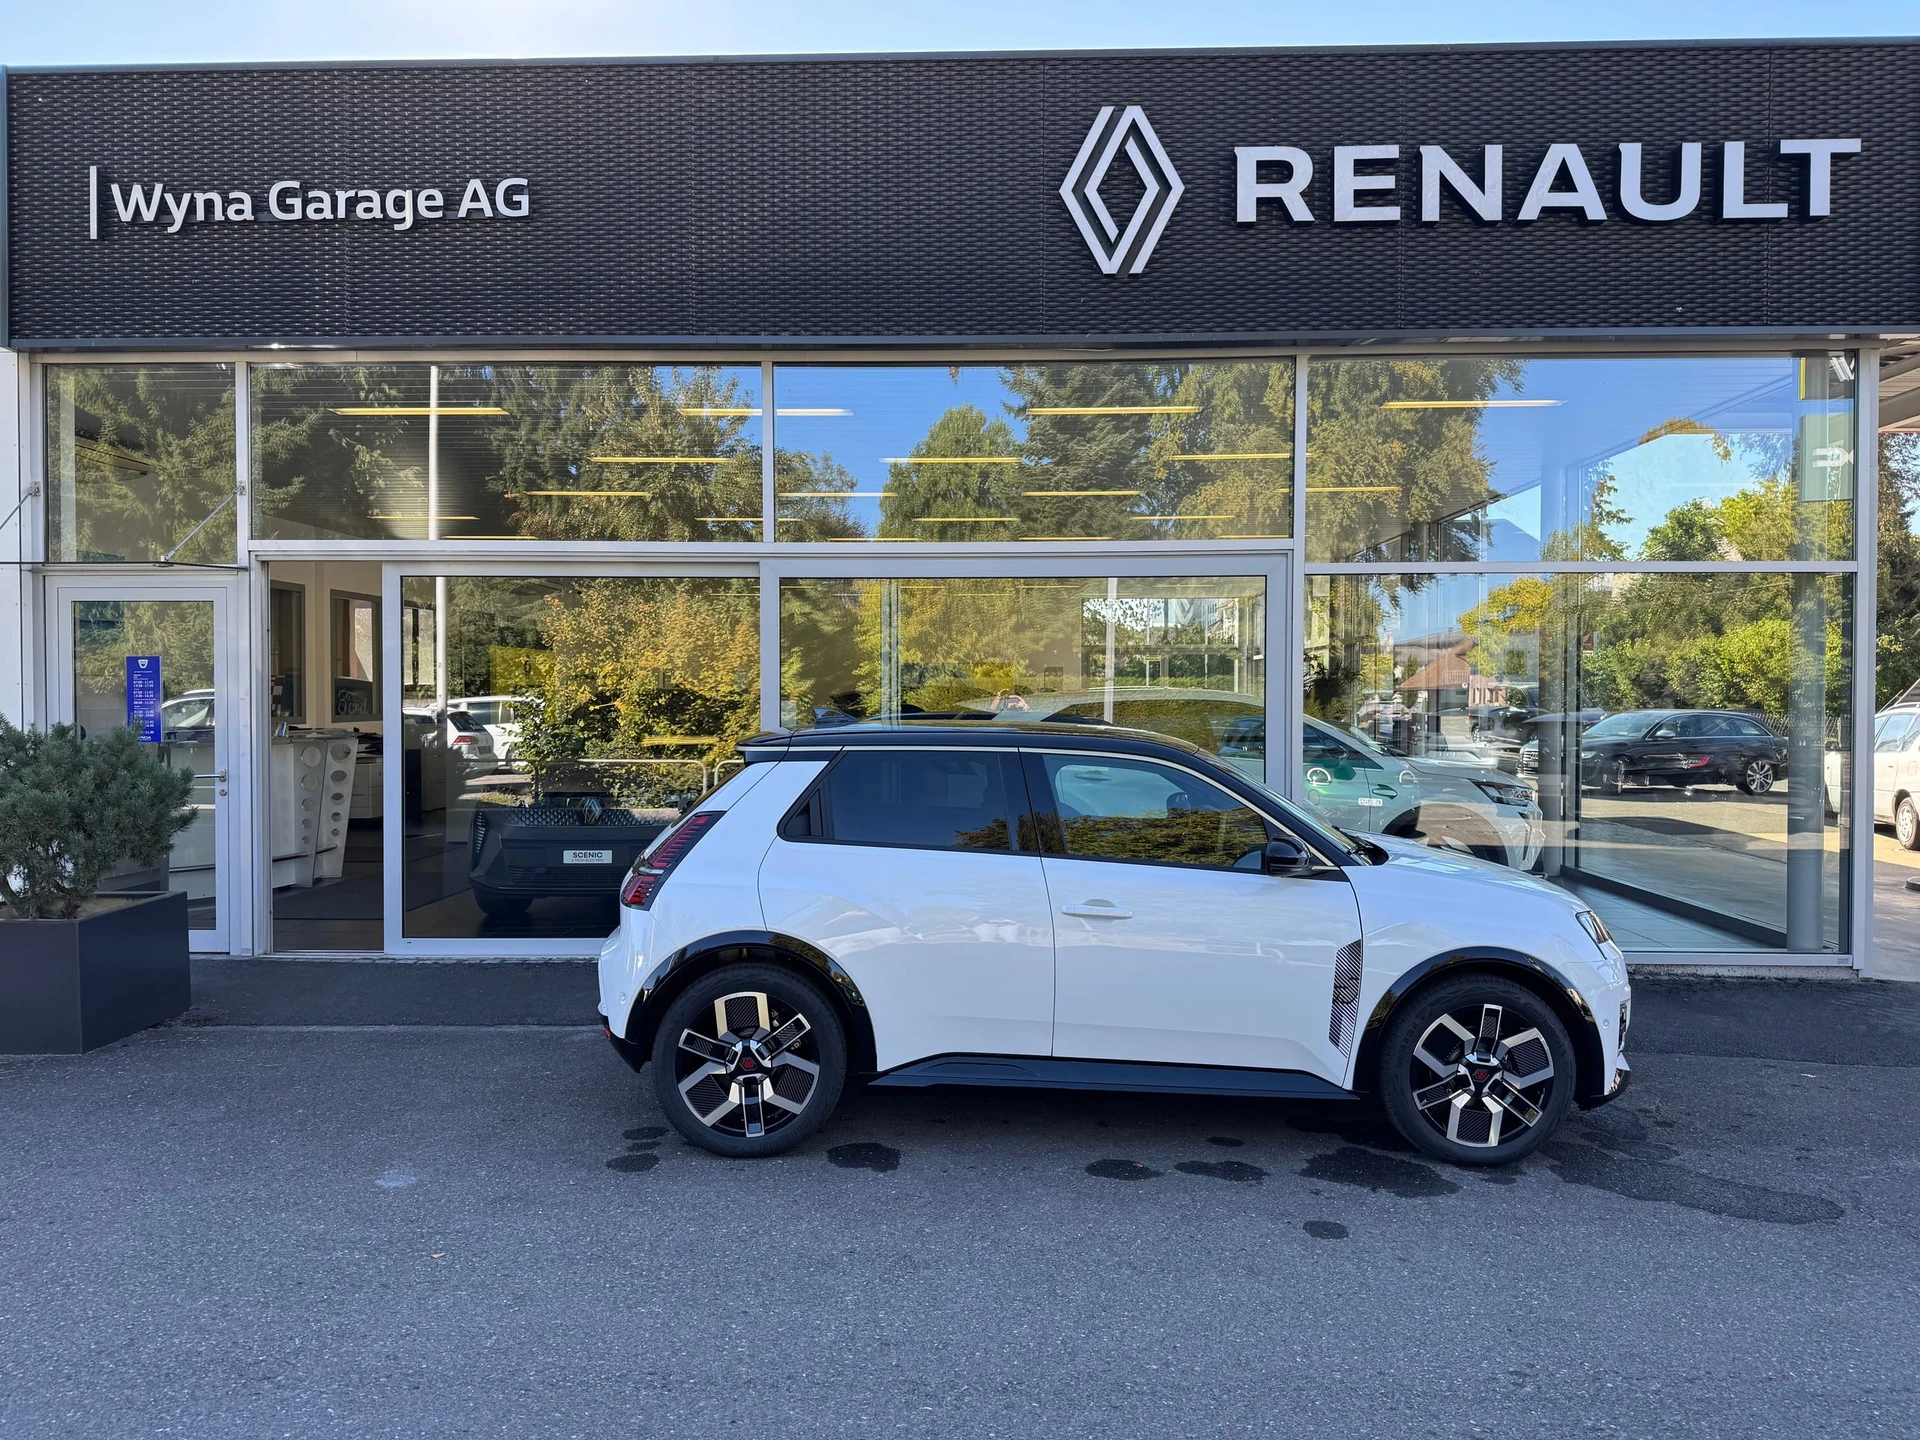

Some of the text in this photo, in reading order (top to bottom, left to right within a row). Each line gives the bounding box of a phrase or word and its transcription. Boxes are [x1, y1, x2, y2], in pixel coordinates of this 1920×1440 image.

[110, 177, 531, 234] Wyna Garage AG
[1233, 137, 1863, 224] RENAULT
[572, 851, 603, 859] SCENIC
